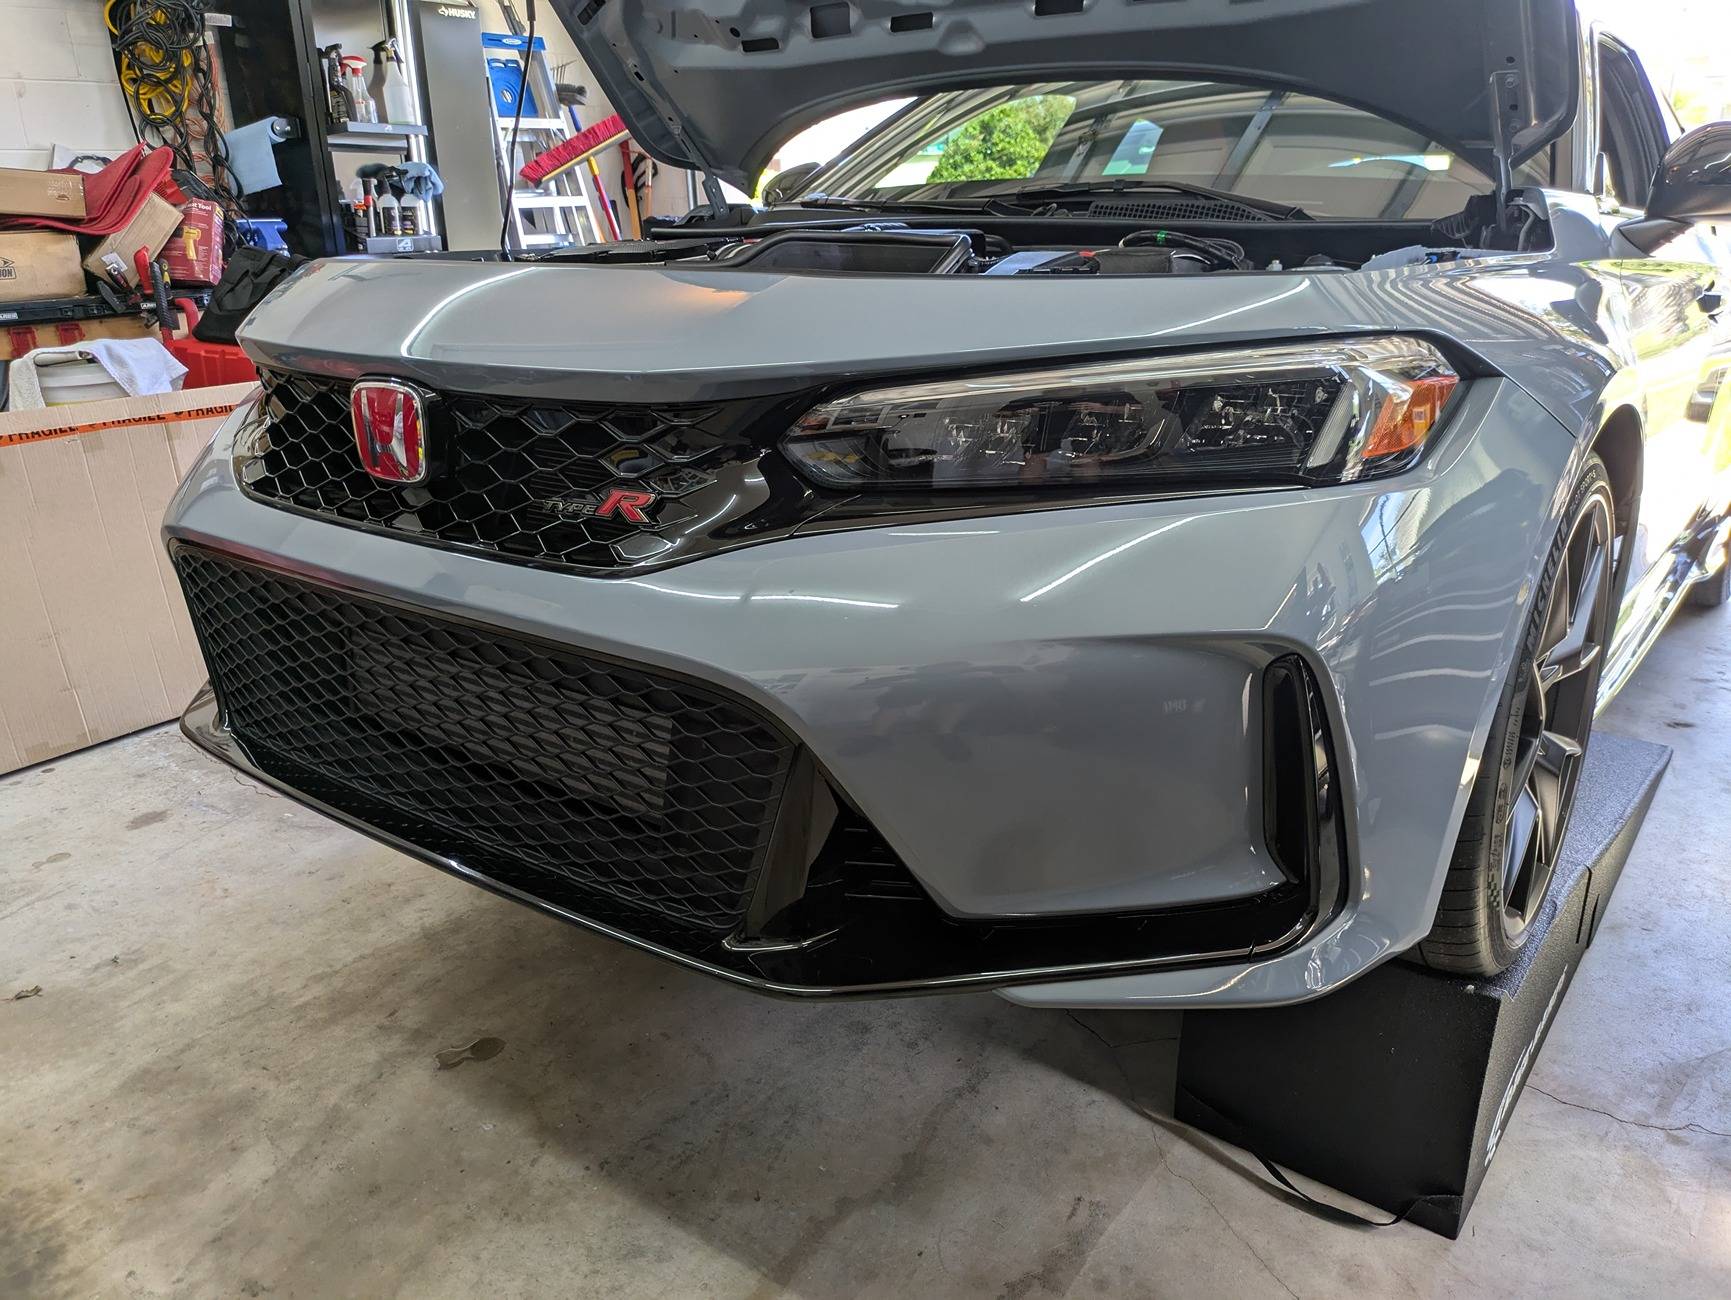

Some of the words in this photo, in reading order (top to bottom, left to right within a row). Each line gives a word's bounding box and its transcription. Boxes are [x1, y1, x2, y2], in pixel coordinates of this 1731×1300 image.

[448, 8, 476, 19] HUSKY
[198, 202, 212, 211] Tool
[543, 498, 597, 516] TYPE
[594, 487, 657, 523] R
[1526, 516, 1569, 653] MICHELIN
